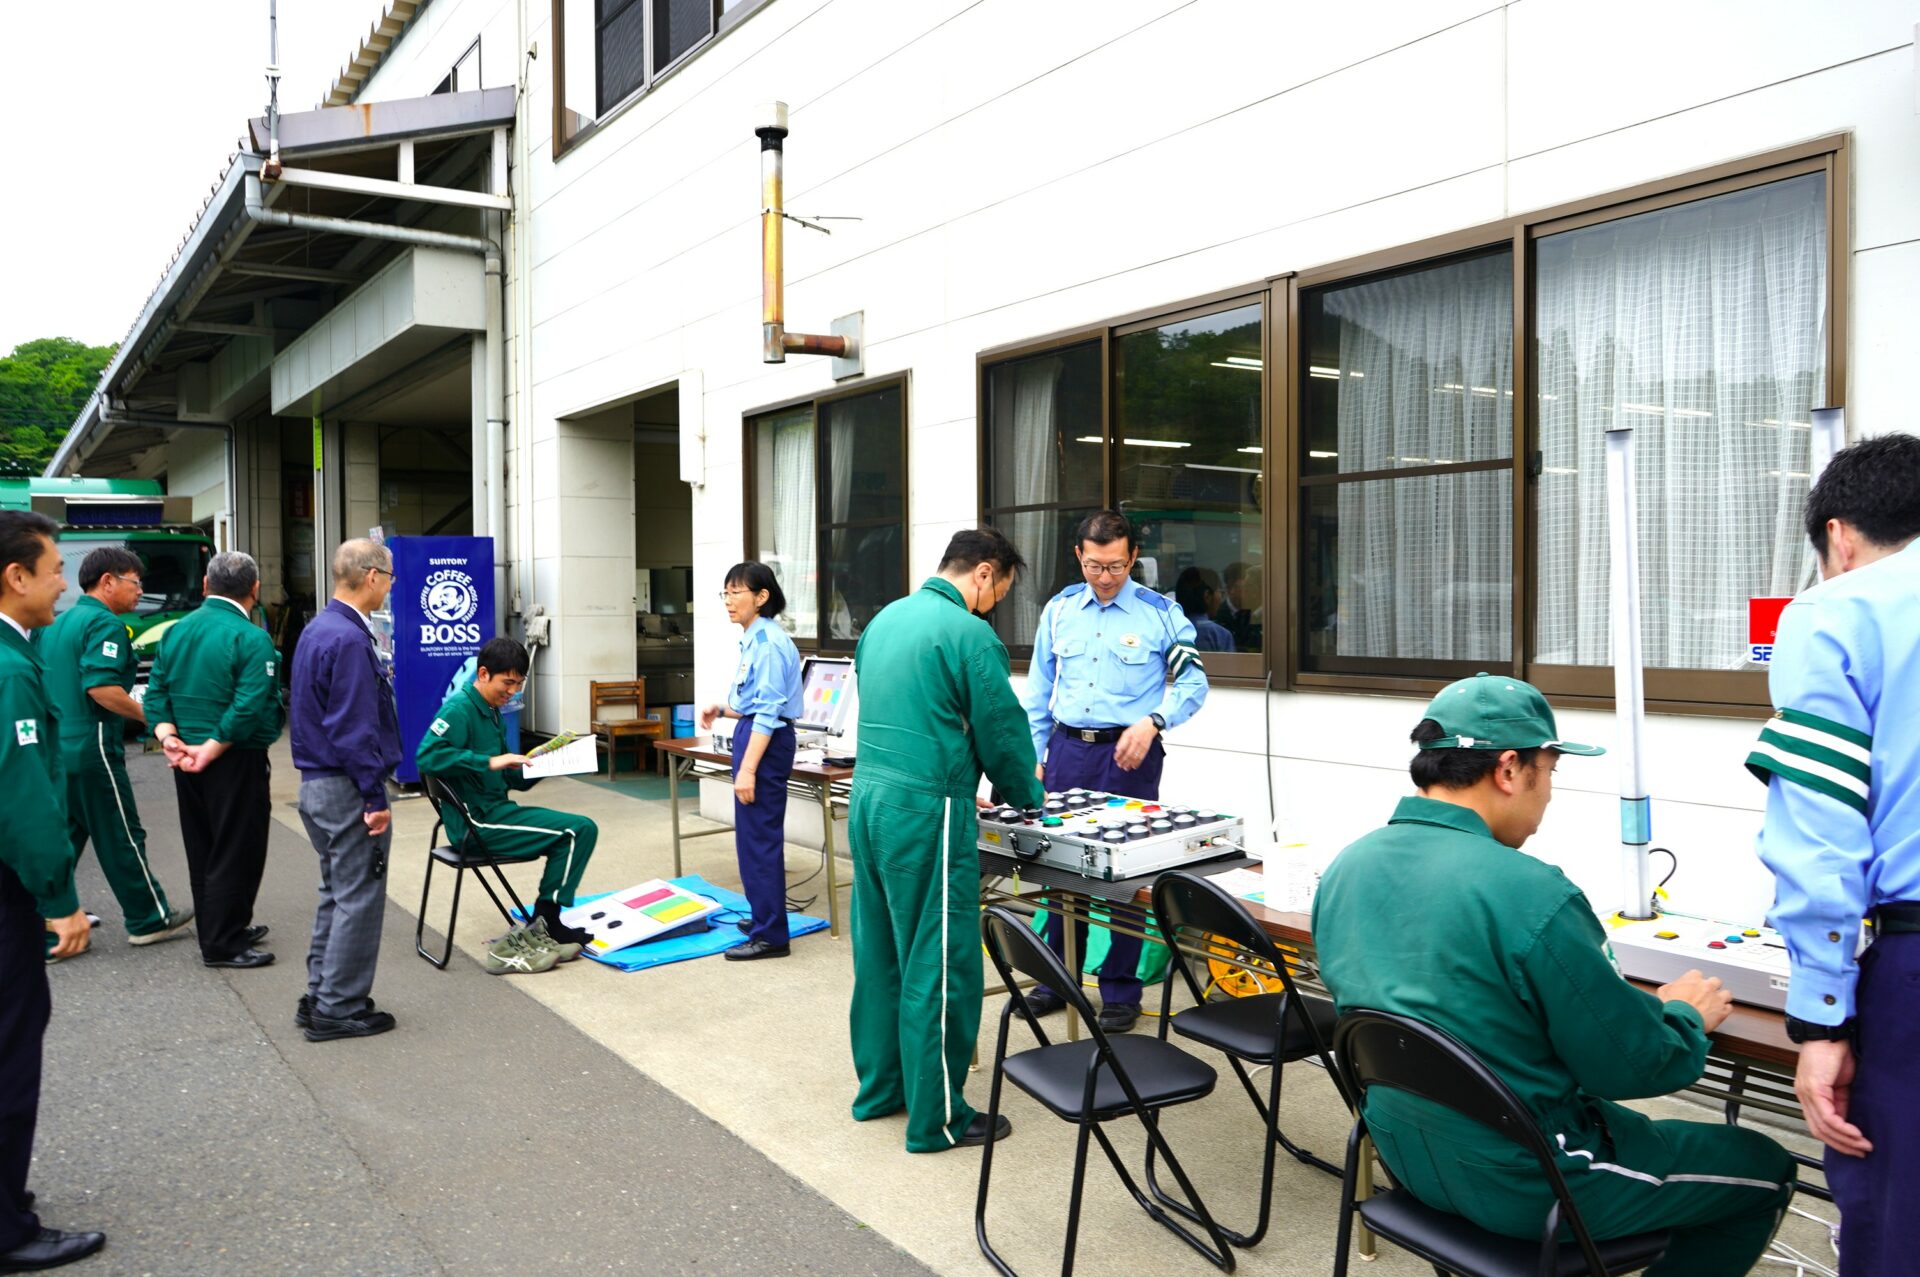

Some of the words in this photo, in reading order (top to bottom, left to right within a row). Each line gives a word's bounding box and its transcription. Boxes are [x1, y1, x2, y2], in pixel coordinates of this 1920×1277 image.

[426, 569, 472, 586] COFFEE
[420, 623, 480, 644] BOSS
[1752, 646, 1773, 661] SE
